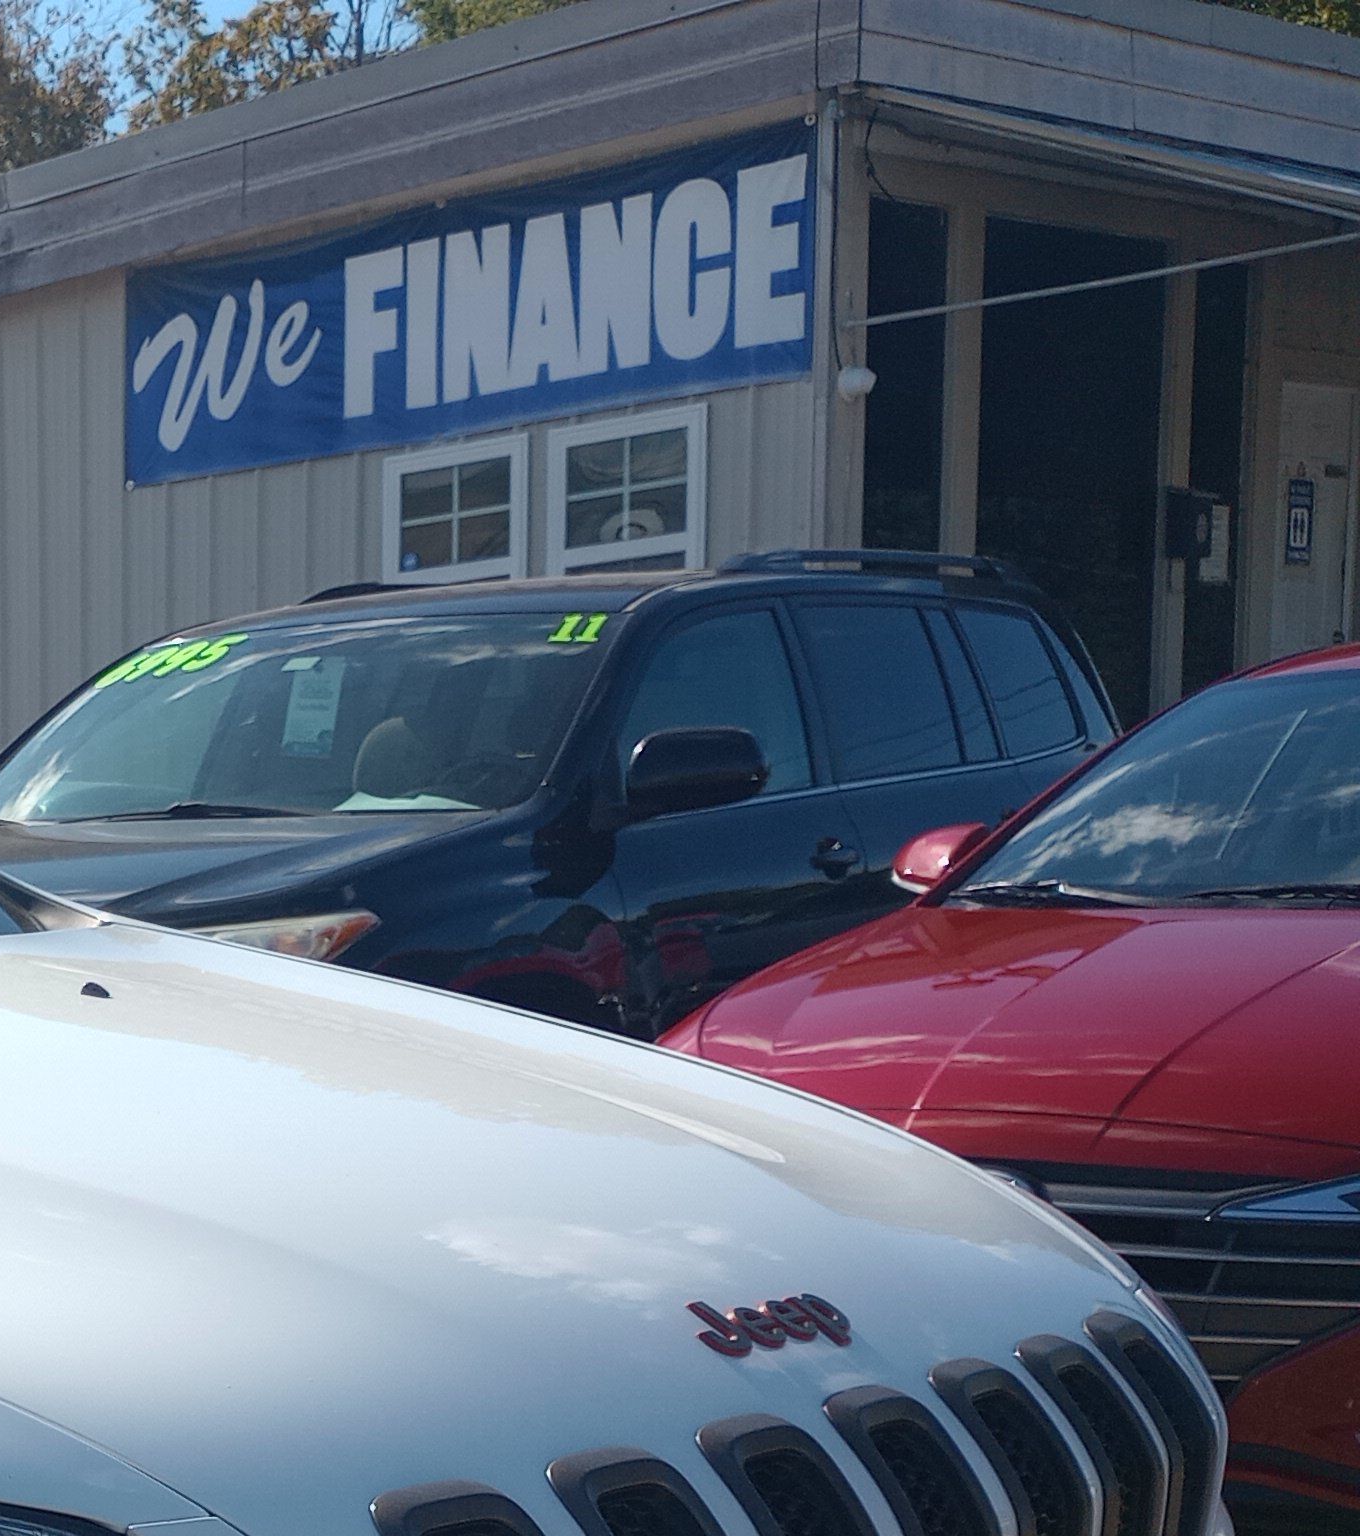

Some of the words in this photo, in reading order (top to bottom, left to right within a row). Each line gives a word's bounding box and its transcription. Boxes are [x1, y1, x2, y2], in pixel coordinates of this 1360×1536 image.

[132, 279, 322, 453] We
[343, 154, 808, 420] FINANCE
[547, 611, 609, 645] 11
[95, 632, 250, 690] 6995
[684, 1292, 853, 1358] Jeep
